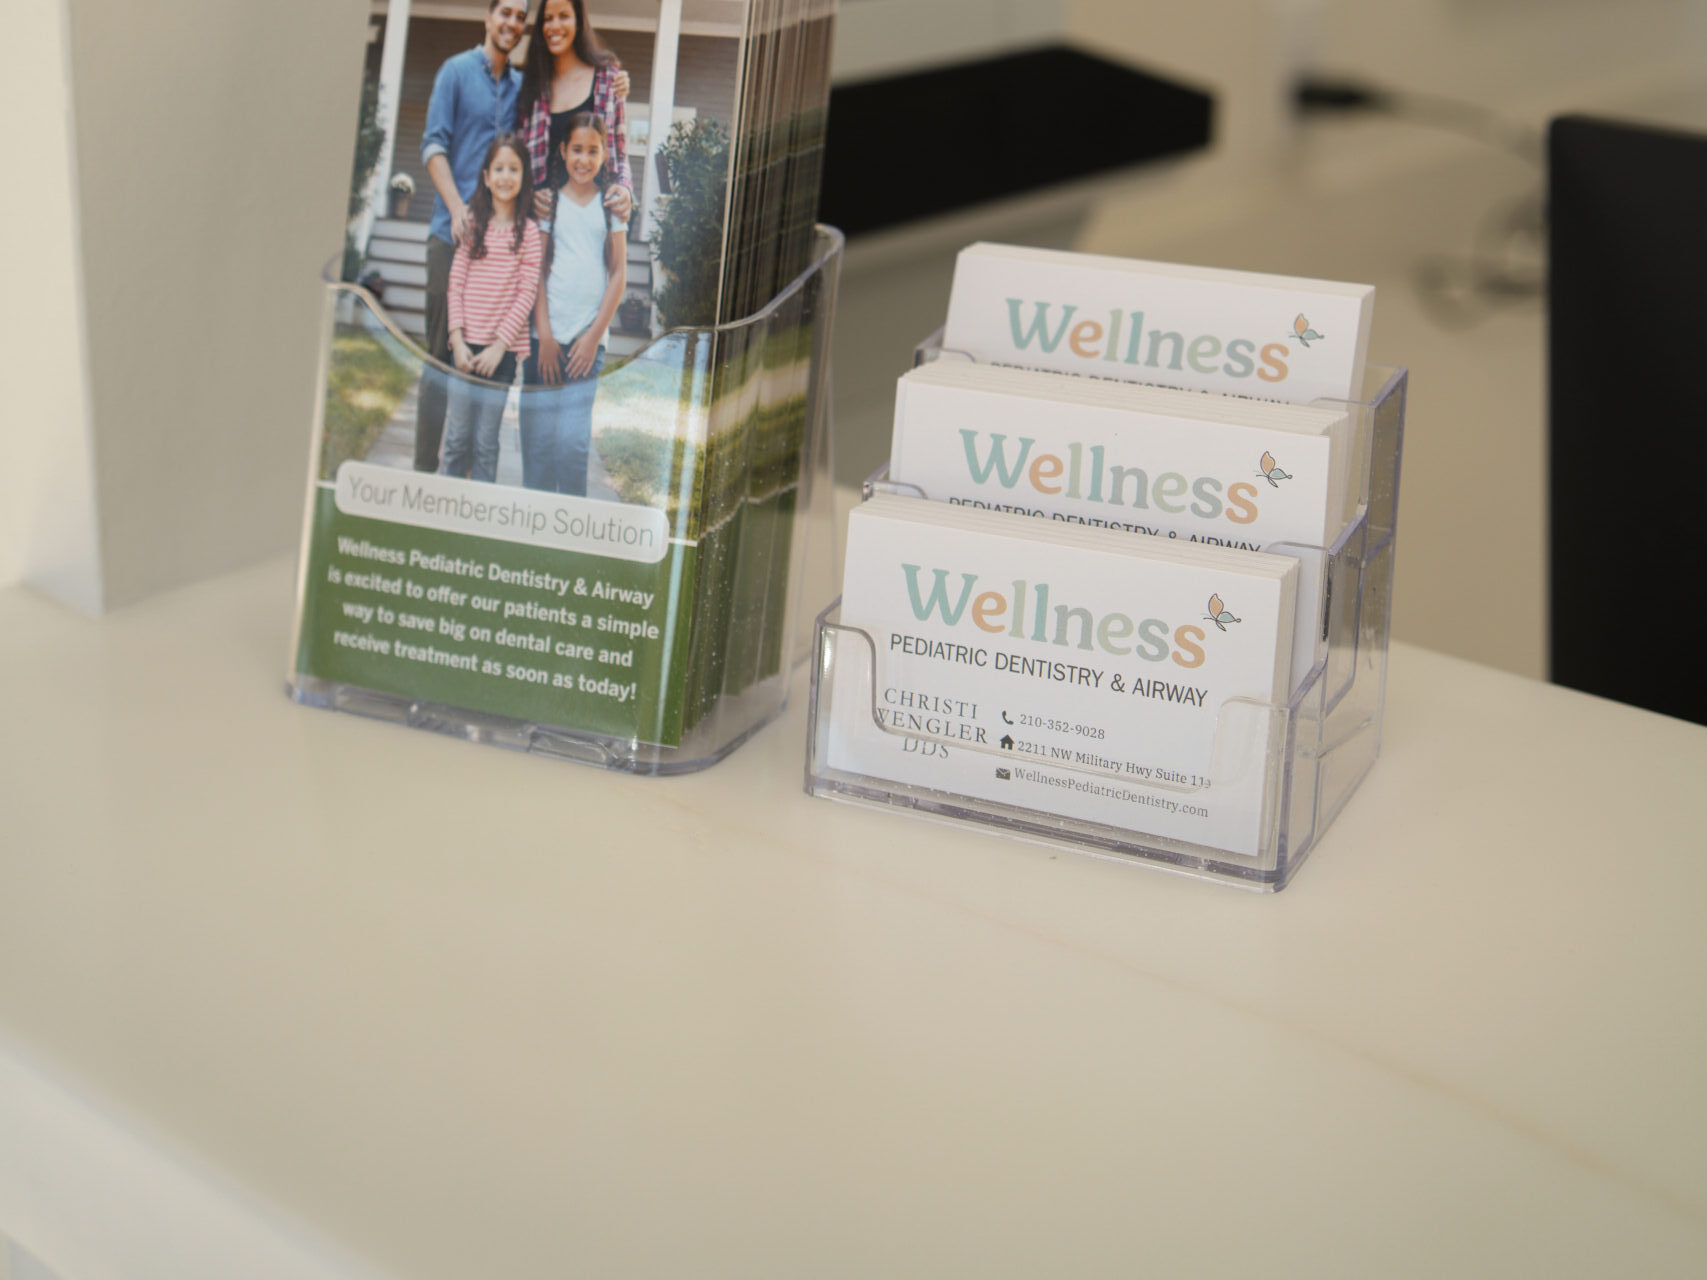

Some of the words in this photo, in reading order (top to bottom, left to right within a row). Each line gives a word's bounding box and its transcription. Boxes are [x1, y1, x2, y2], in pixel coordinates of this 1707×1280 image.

[1005, 297, 1290, 383] Wellness
[348, 474, 398, 506] Your
[401, 485, 547, 535] Membership
[553, 508, 655, 547] Solution
[958, 428, 1259, 525] Wellness
[328, 564, 342, 585] is
[344, 568, 402, 596] excited
[406, 576, 423, 599] to
[426, 583, 467, 607] offer
[471, 595, 500, 613] our
[503, 598, 577, 627] patients
[581, 614, 592, 629] a
[596, 613, 660, 641] simple
[337, 536, 406, 566] Wellness
[409, 549, 484, 579] Pediatric
[488, 562, 570, 597] Dentistry
[573, 578, 588, 596] &
[591, 581, 654, 610] Airway
[342, 601, 374, 624] way
[377, 601, 395, 624] to
[398, 612, 436, 633] save
[438, 614, 466, 642] big
[469, 626, 492, 643] on
[495, 625, 551, 654] dental
[555, 640, 595, 661] care
[598, 642, 633, 668] and
[901, 563, 1206, 669] Wellness
[333, 628, 390, 655] receive
[394, 640, 478, 672] treatment
[481, 658, 502, 677] as
[505, 663, 549, 685] soon
[552, 670, 573, 689] as
[578, 673, 637, 701] today!
[890, 633, 988, 667] PEDIATRIC
[994, 651, 1104, 689] DENTISTRY
[1110, 673, 1125, 693] &
[1132, 677, 1208, 707] AIRWAY
[884, 687, 978, 719] CHRISTI
[1019, 713, 1105, 740] 210-352-9028
[902, 737, 949, 759] DDS
[1017, 740, 1047, 756] 2211
[1050, 747, 1073, 761] NW
[1075, 752, 1123, 773] Military
[1125, 762, 1152, 779] Hwy
[1155, 768, 1187, 784] Suite
[1014, 767, 1209, 818] WellnessPediatricDentistry.com
